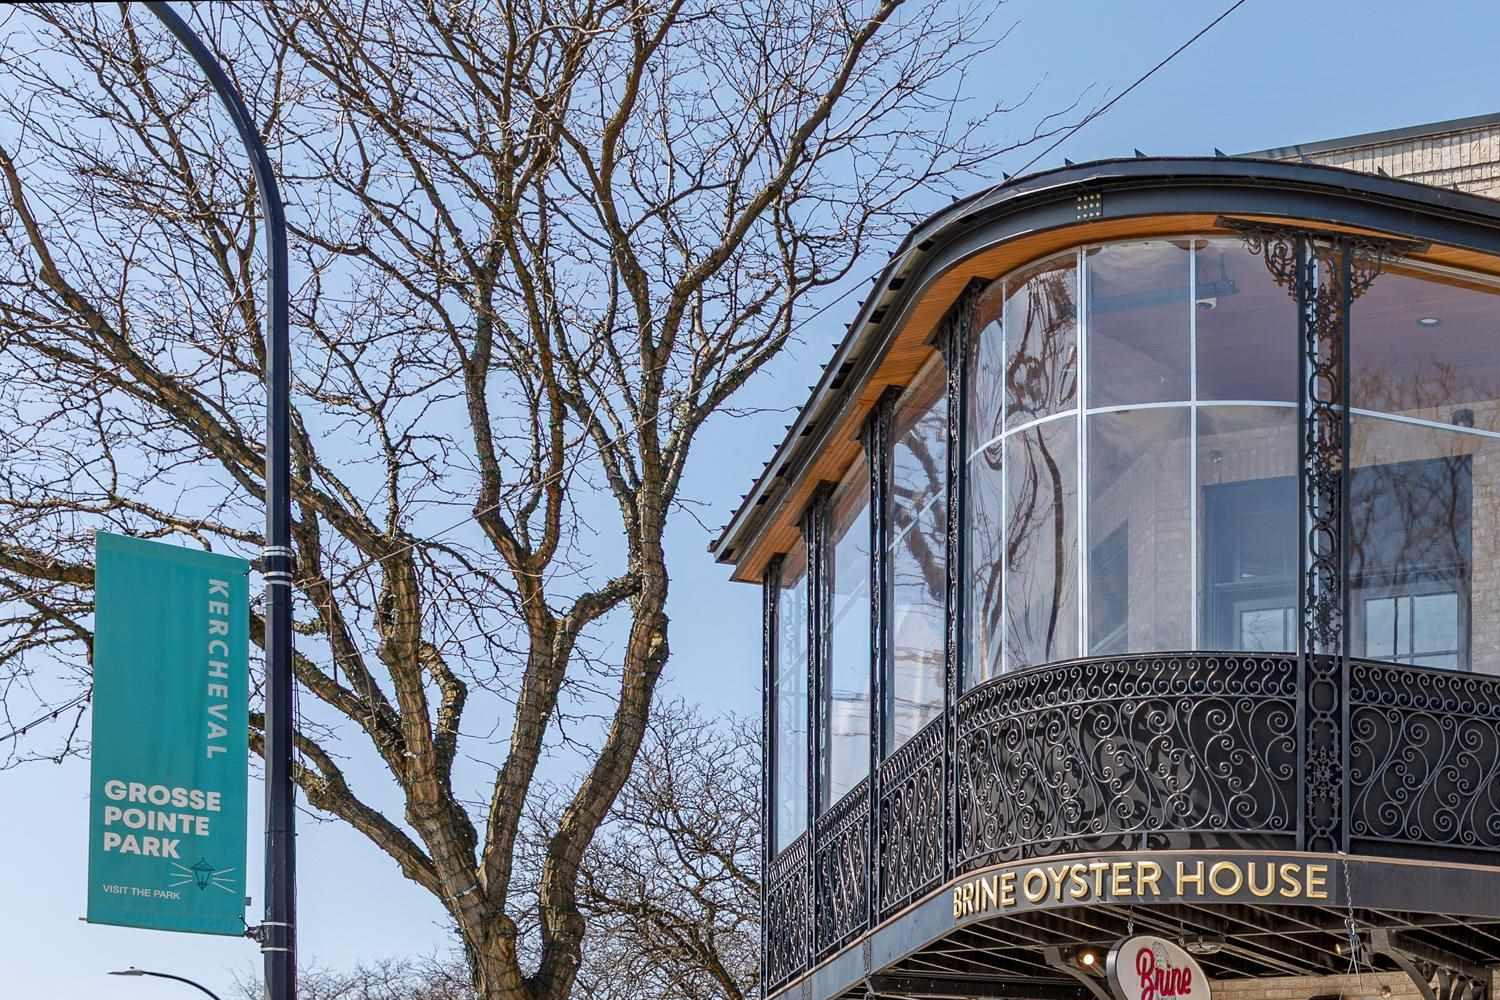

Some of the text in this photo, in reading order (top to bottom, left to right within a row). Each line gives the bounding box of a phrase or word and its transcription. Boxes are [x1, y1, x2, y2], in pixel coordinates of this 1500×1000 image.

[207, 579, 229, 758] KERCHEVAL
[105, 780, 221, 812] GROSSE
[105, 806, 210, 836] POINTE
[104, 832, 180, 859] PARK
[103, 885, 180, 901] VISIT THE PARK
[953, 861, 1328, 918] BRINE OYSTER HOUSE
